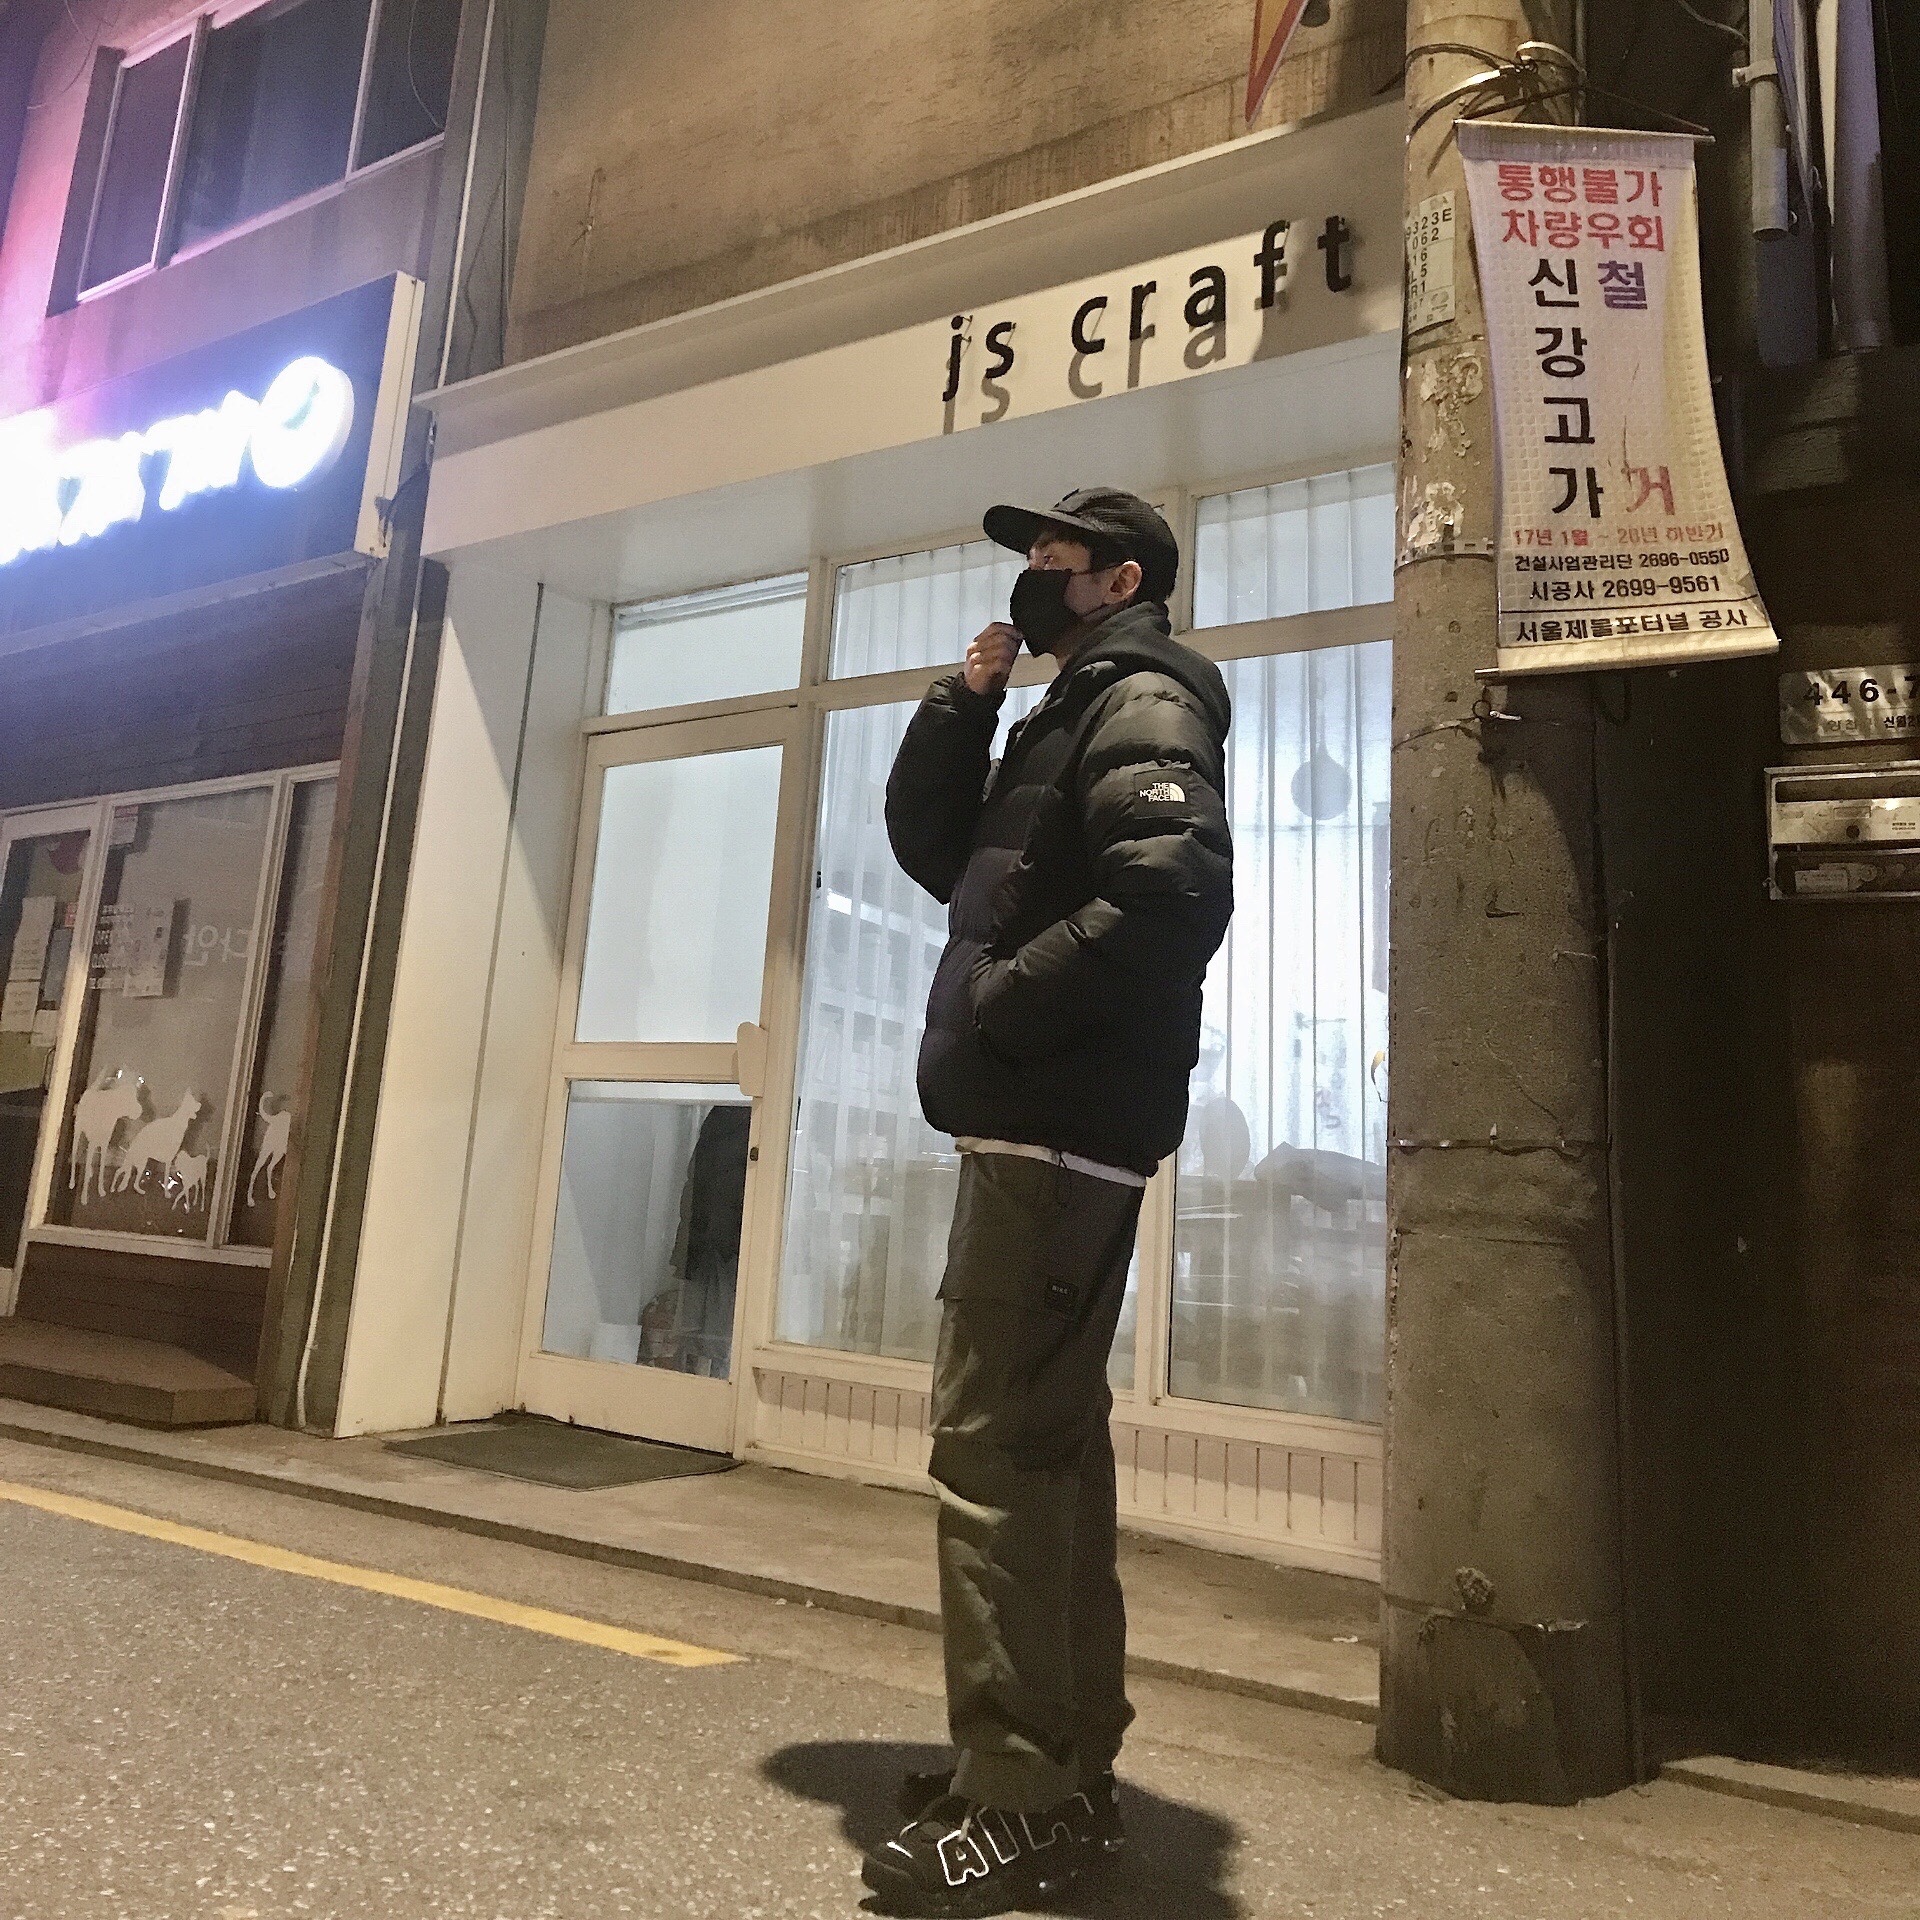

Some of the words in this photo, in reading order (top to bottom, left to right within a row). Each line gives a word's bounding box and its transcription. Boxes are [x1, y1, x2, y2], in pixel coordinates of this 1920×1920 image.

[1497, 164, 1663, 207] 통행불가
[1501, 209, 1666, 251] 차량우회
[942, 315, 1016, 402] js
[1071, 215, 1352, 354] craft
[1514, 528, 1552, 546] 17년
[1514, 553, 1634, 572] 건설사업관리단
[1638, 548, 1730, 569] 2696-0550
[1530, 579, 1595, 601] 시공사
[1602, 575, 1720, 599] 2699-9561
[1698, 609, 1748, 629] 공사
[1139, 788, 1170, 798] NORTH
[1148, 795, 1171, 803] FACE
